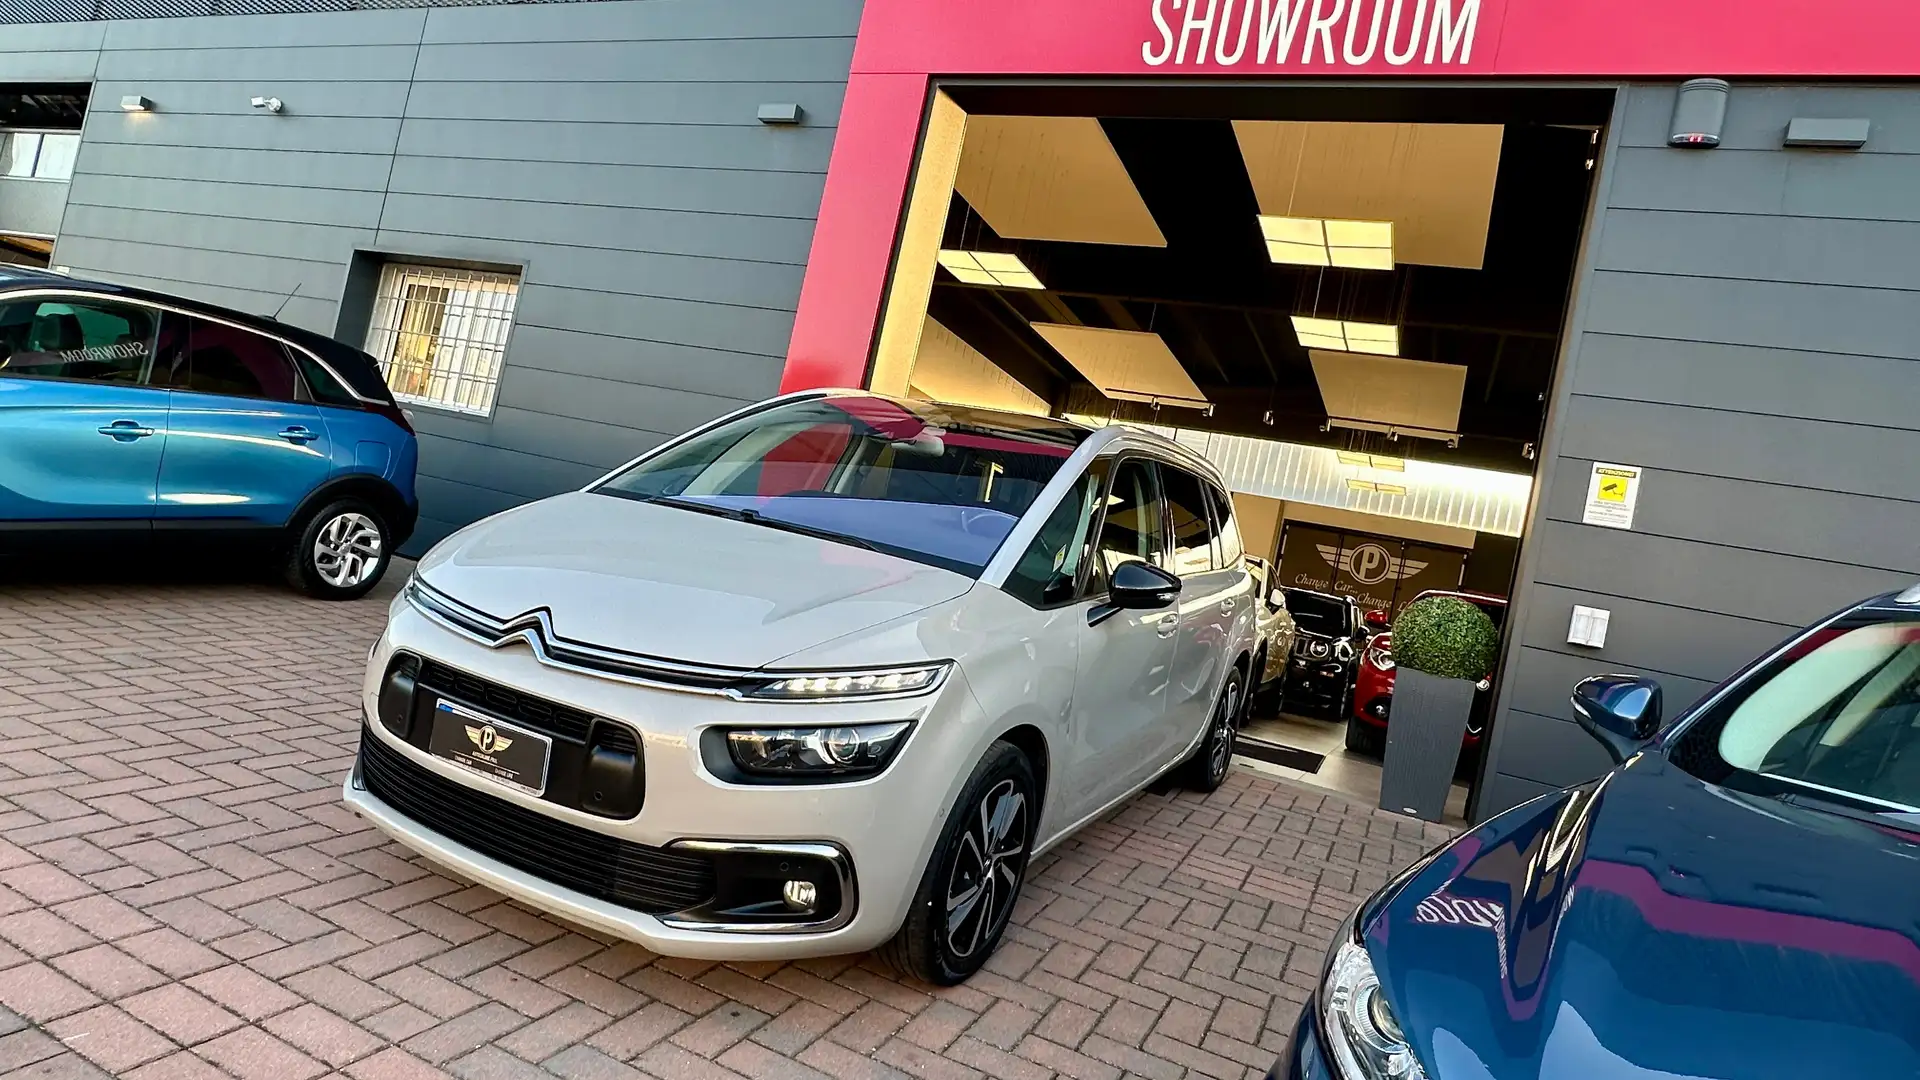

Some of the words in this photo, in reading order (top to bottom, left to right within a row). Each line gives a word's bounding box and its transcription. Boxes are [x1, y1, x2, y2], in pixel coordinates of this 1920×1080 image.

[1141, 0, 1482, 66] SHOWROOM
[1295, 573, 1329, 590] Change
[1356, 592, 1392, 610] Change
